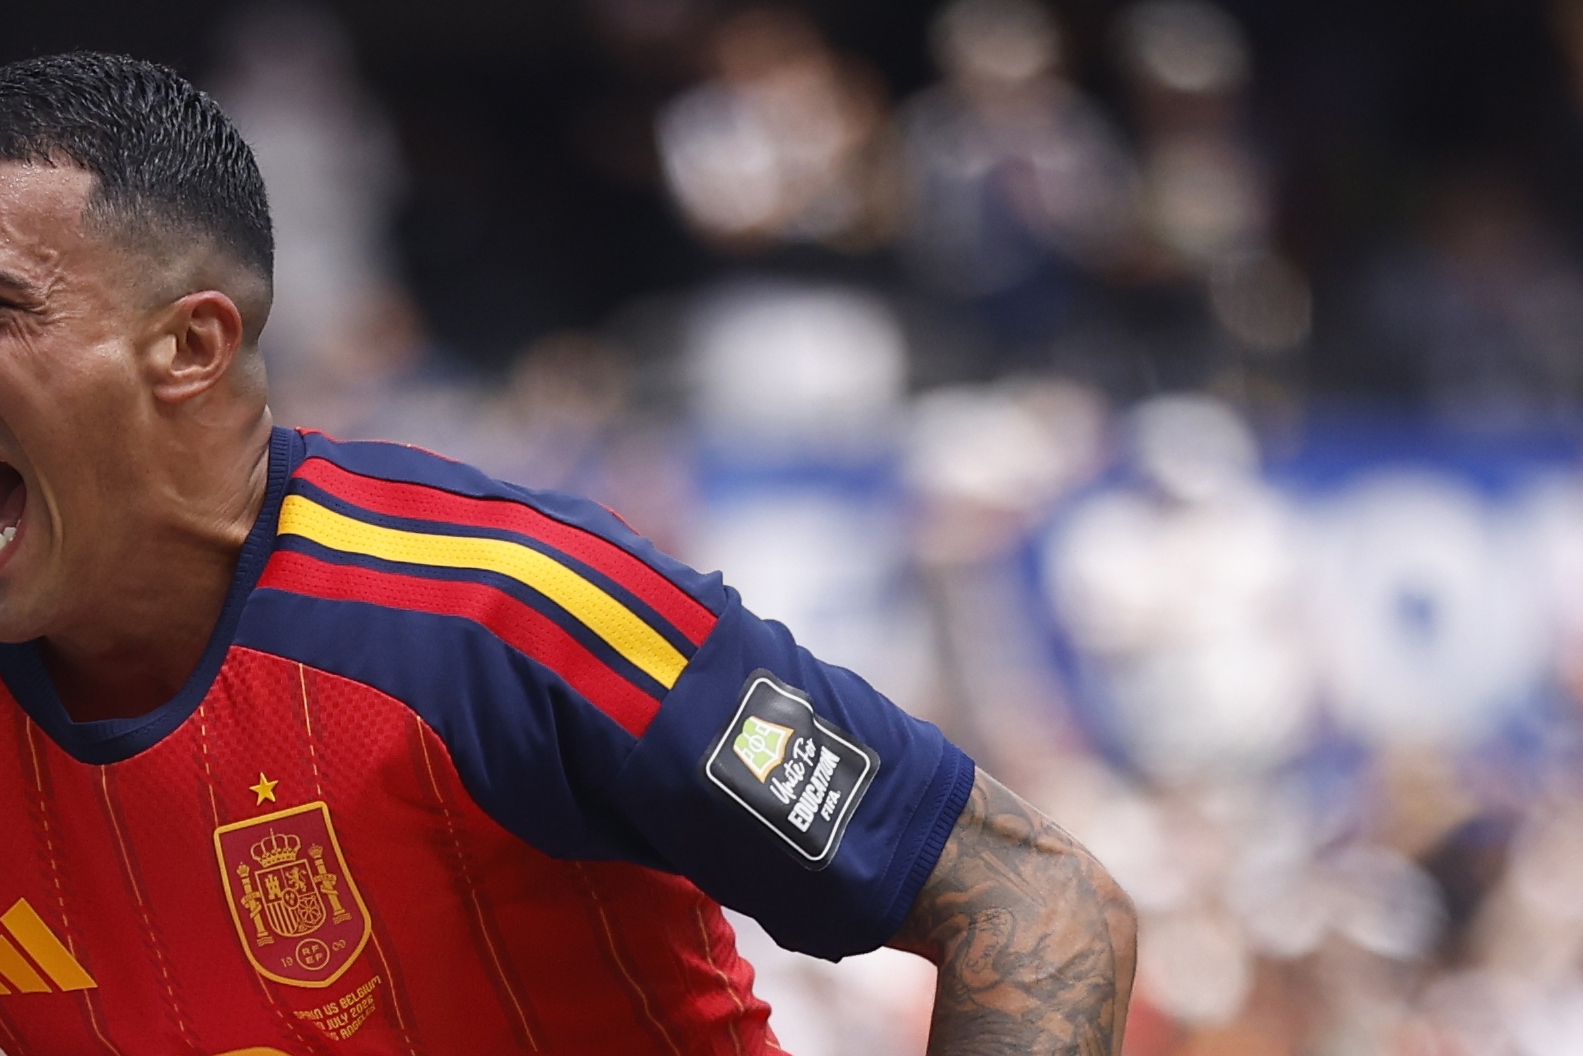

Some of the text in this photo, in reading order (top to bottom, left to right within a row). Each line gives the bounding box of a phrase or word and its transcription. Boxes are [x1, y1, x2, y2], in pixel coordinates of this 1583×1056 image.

[769, 737, 817, 805] Unite For
[787, 746, 841, 832] EDUCATION
[820, 790, 841, 822] FIFA
[339, 975, 382, 1009] BELGIUM
[326, 1012, 349, 1031] JULY
